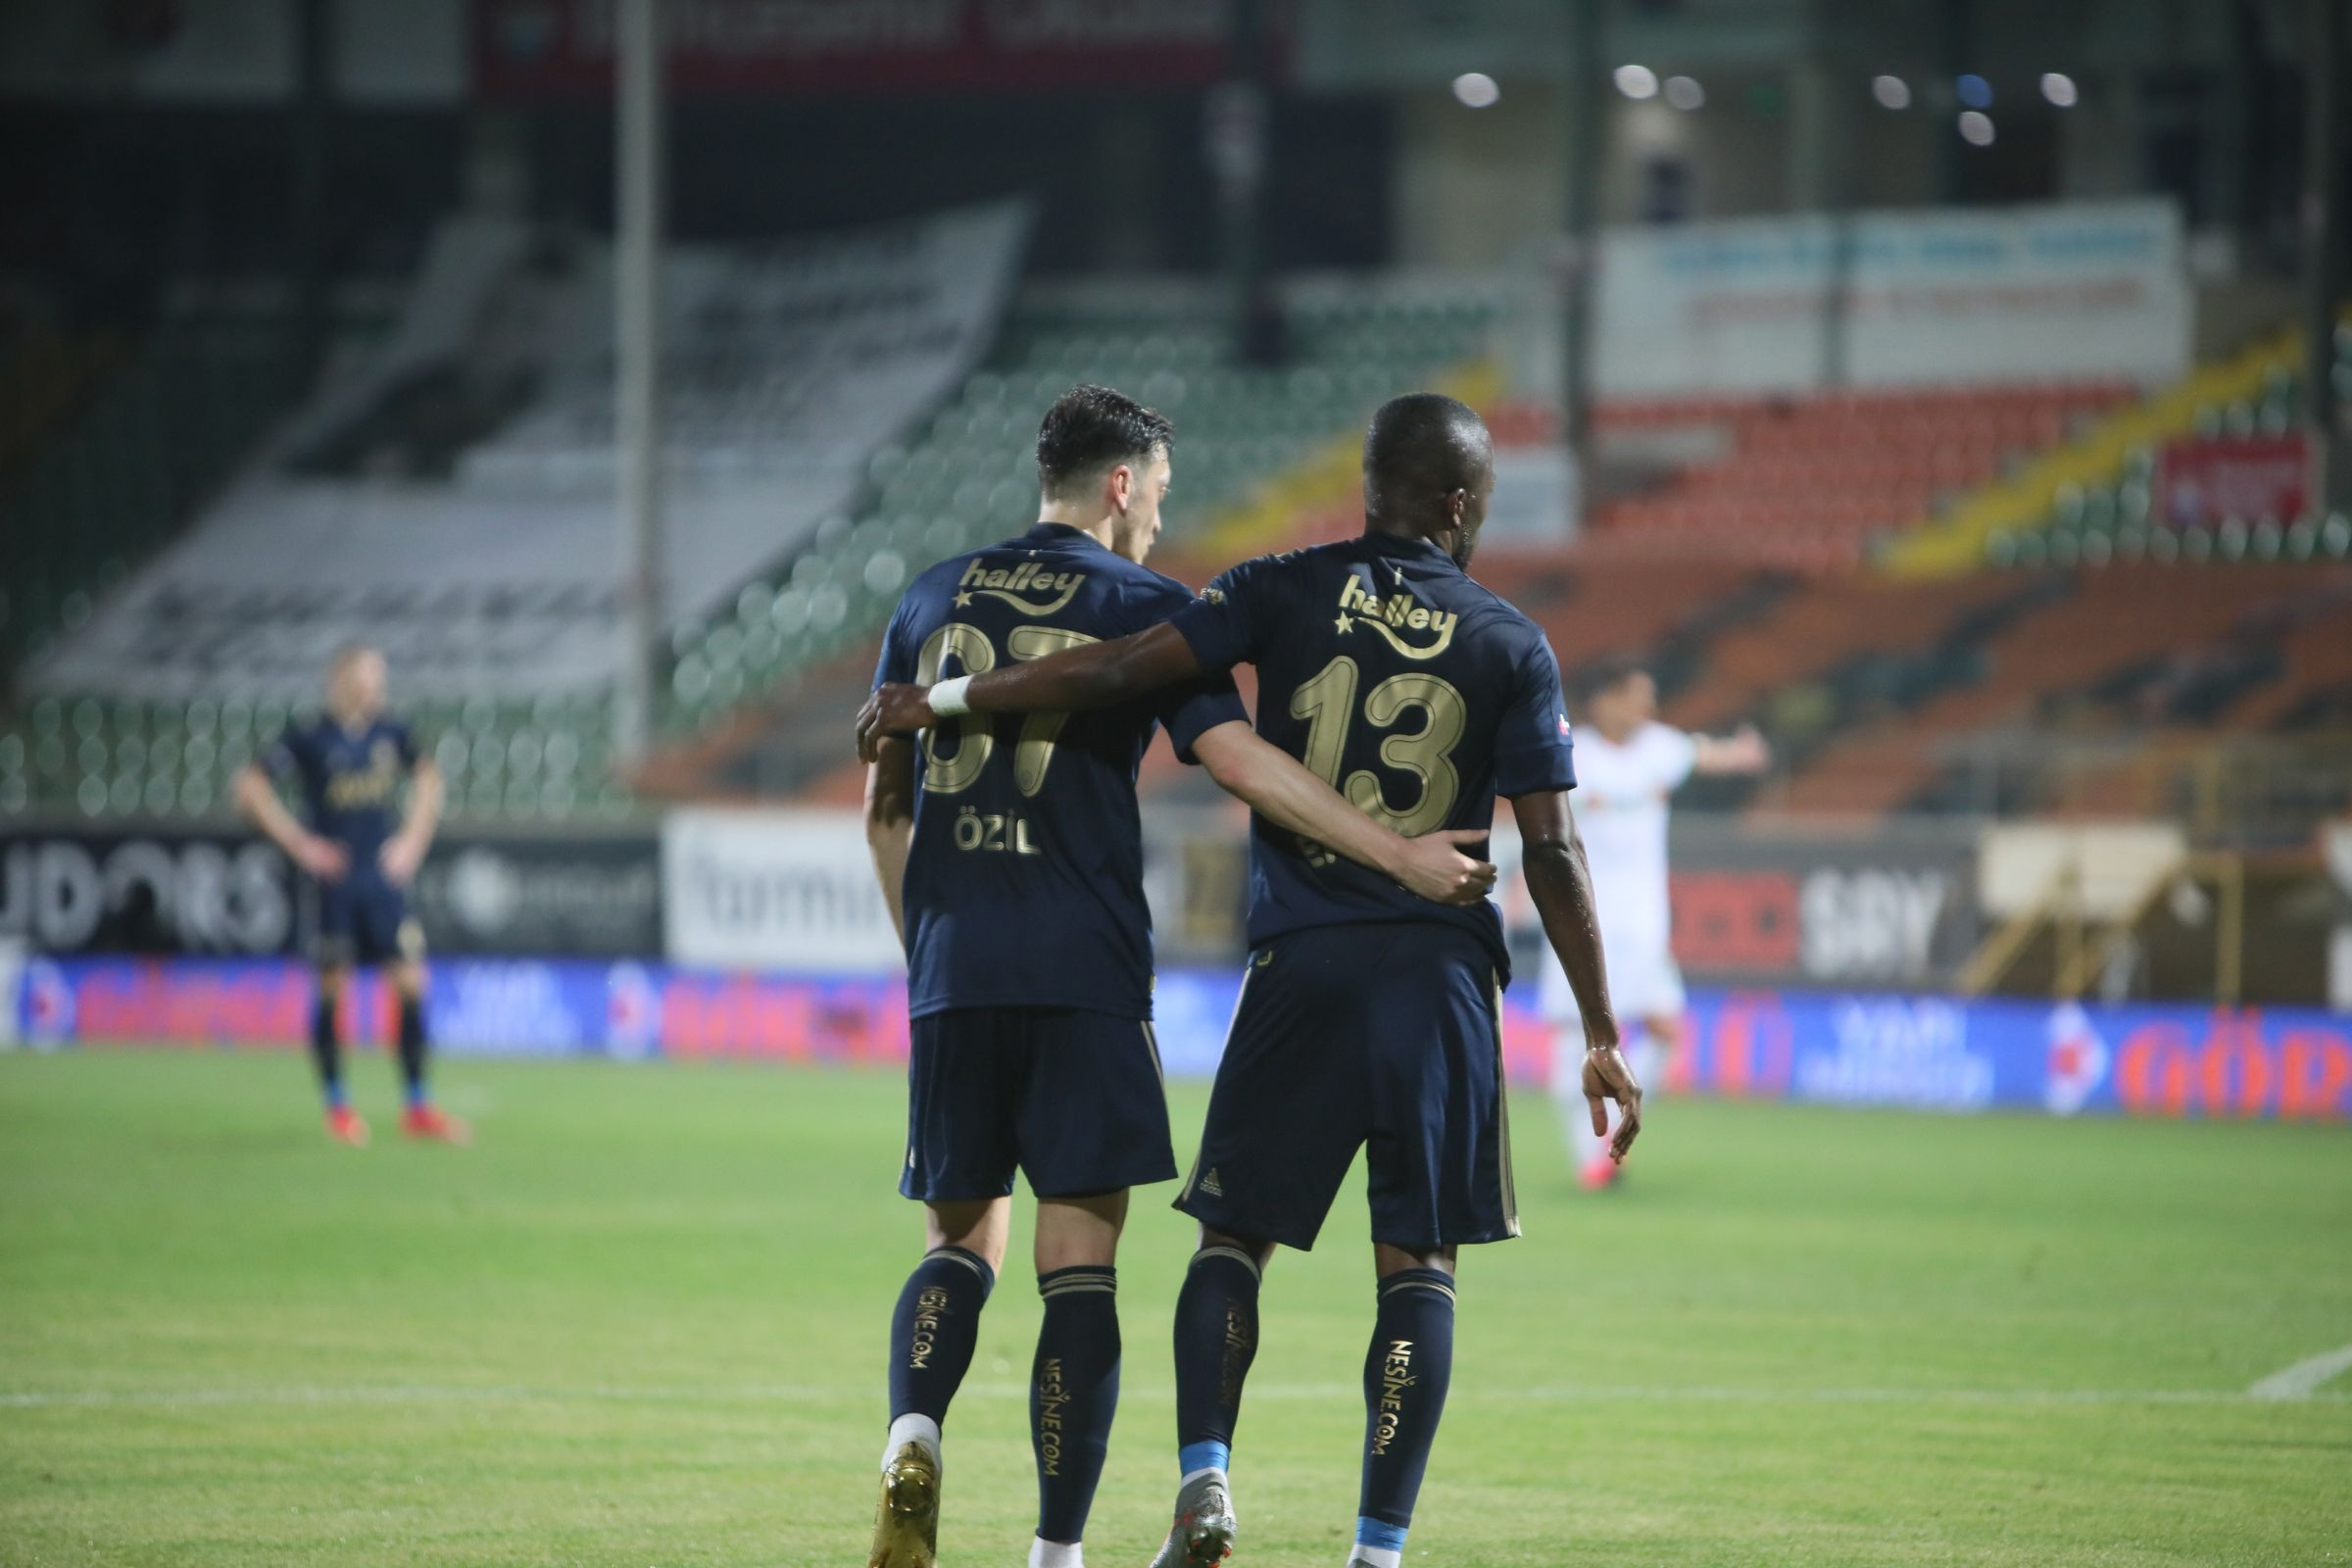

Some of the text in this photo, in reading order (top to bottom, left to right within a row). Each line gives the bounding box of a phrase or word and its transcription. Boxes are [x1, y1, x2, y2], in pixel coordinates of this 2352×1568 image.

[958, 558, 1086, 616] halley
[1337, 574, 1458, 660] halley
[1290, 655, 1467, 838] 13
[955, 806, 1041, 855] ÖZİL
